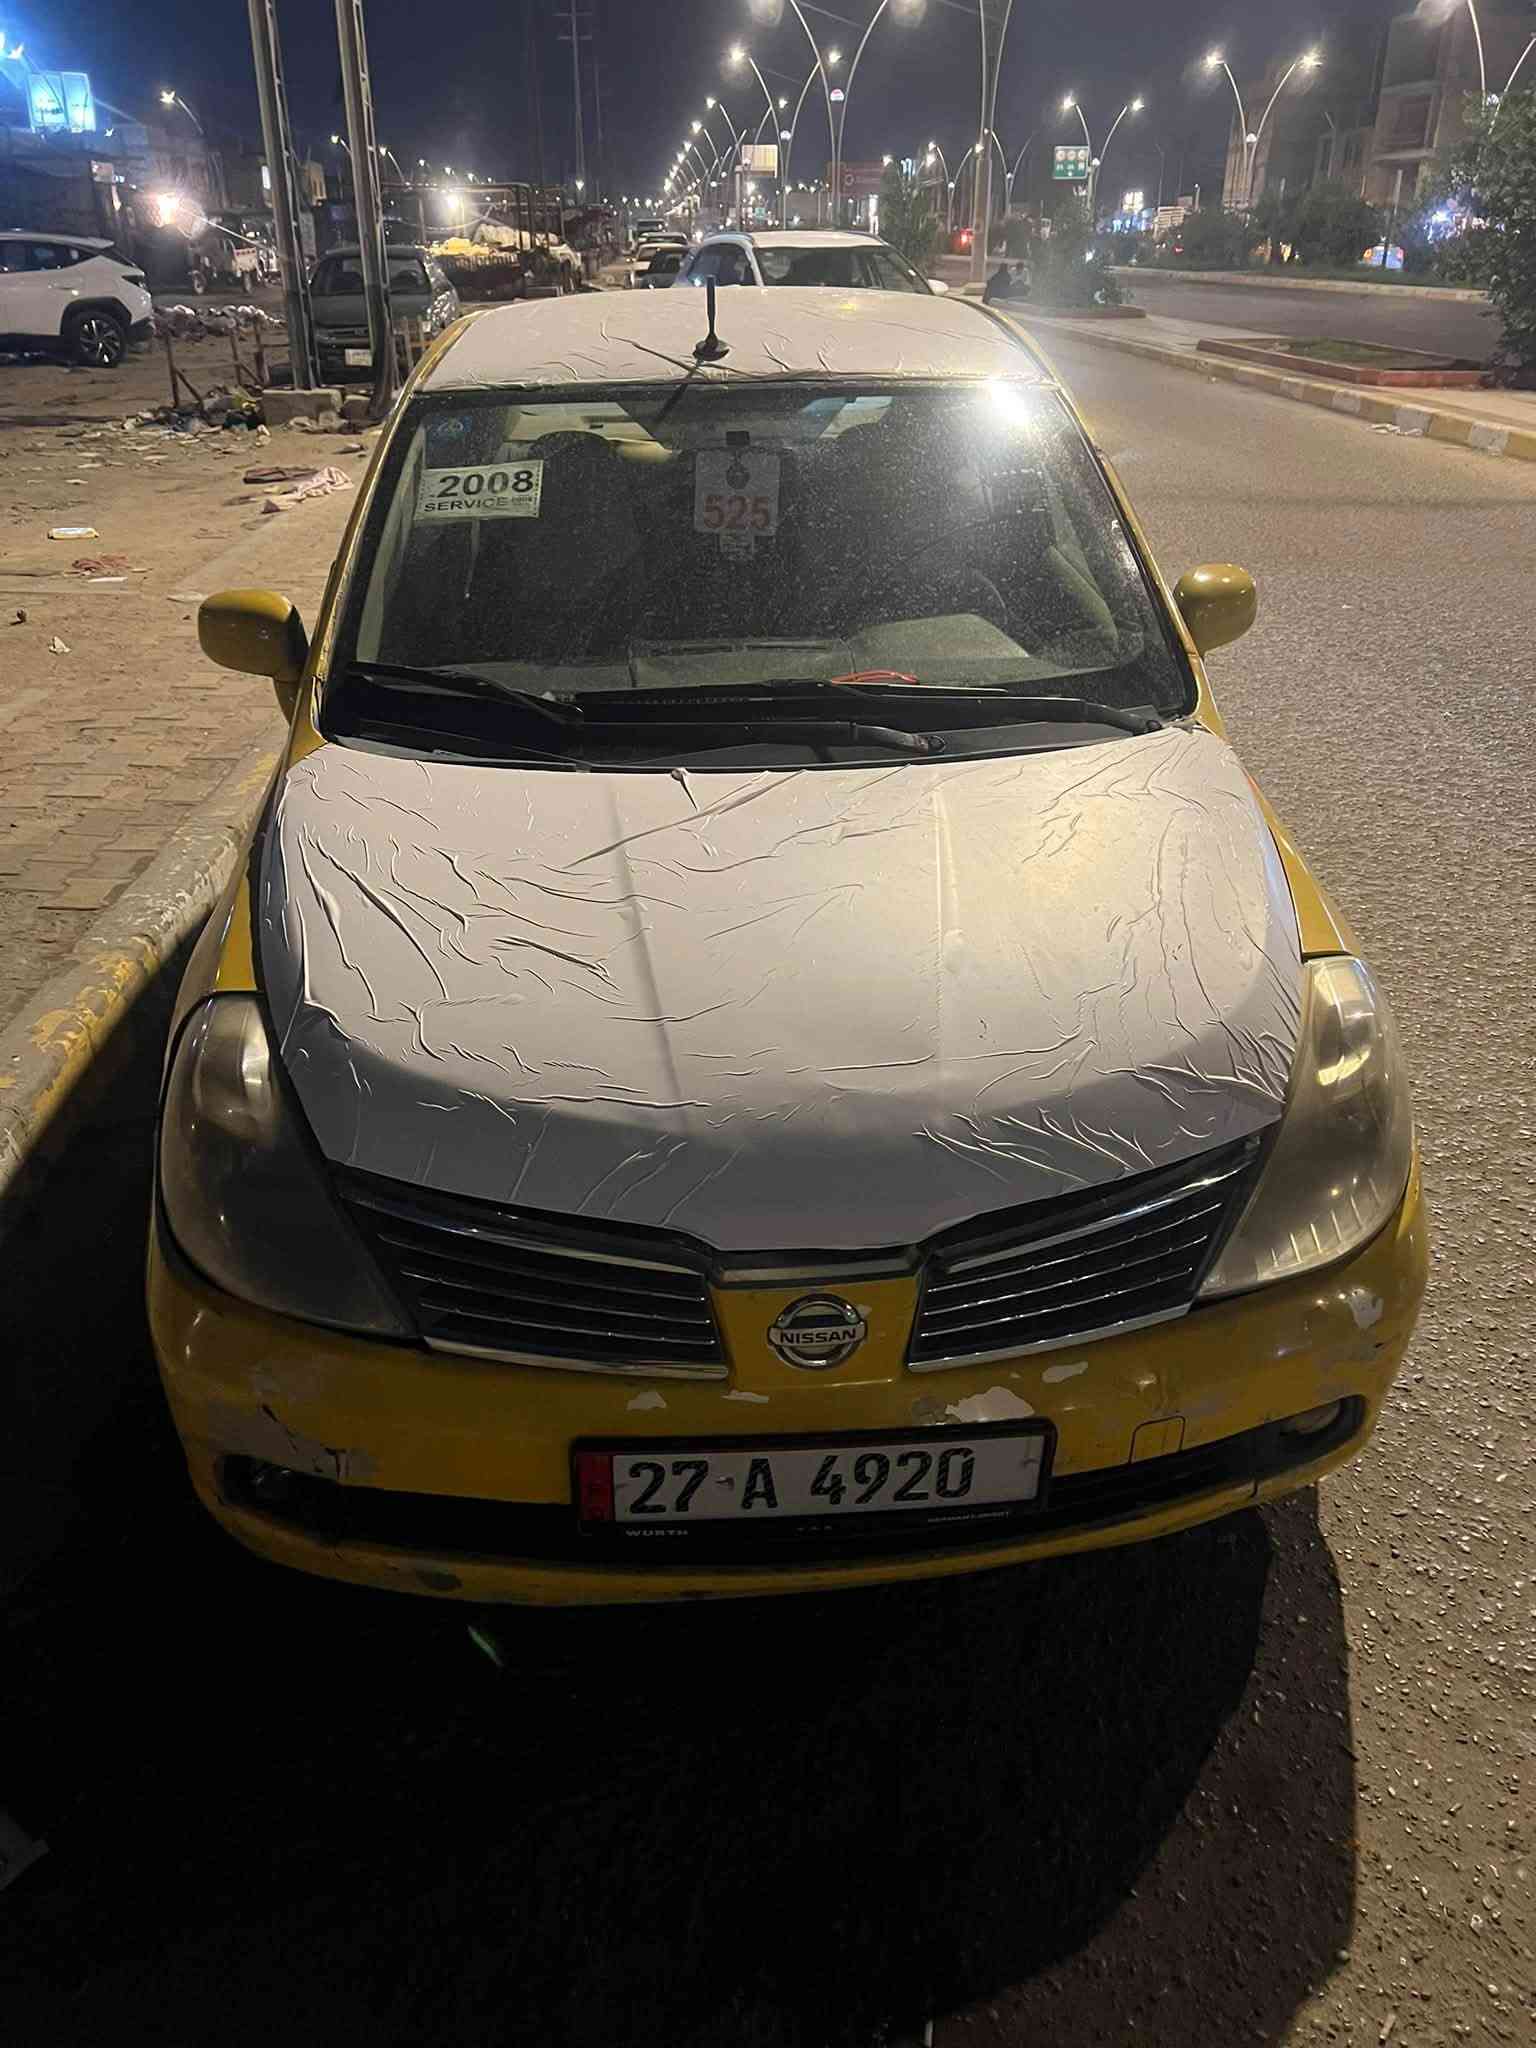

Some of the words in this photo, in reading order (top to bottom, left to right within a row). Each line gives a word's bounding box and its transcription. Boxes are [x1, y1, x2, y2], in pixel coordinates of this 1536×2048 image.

[437, 470, 533, 498] 2008
[424, 497, 508, 512] SERVICE
[703, 495, 769, 529] 525
[780, 1328, 857, 1345] NISSAN
[628, 1461, 709, 1514] 27
[740, 1458, 779, 1509] A
[811, 1446, 976, 1506] 4920
